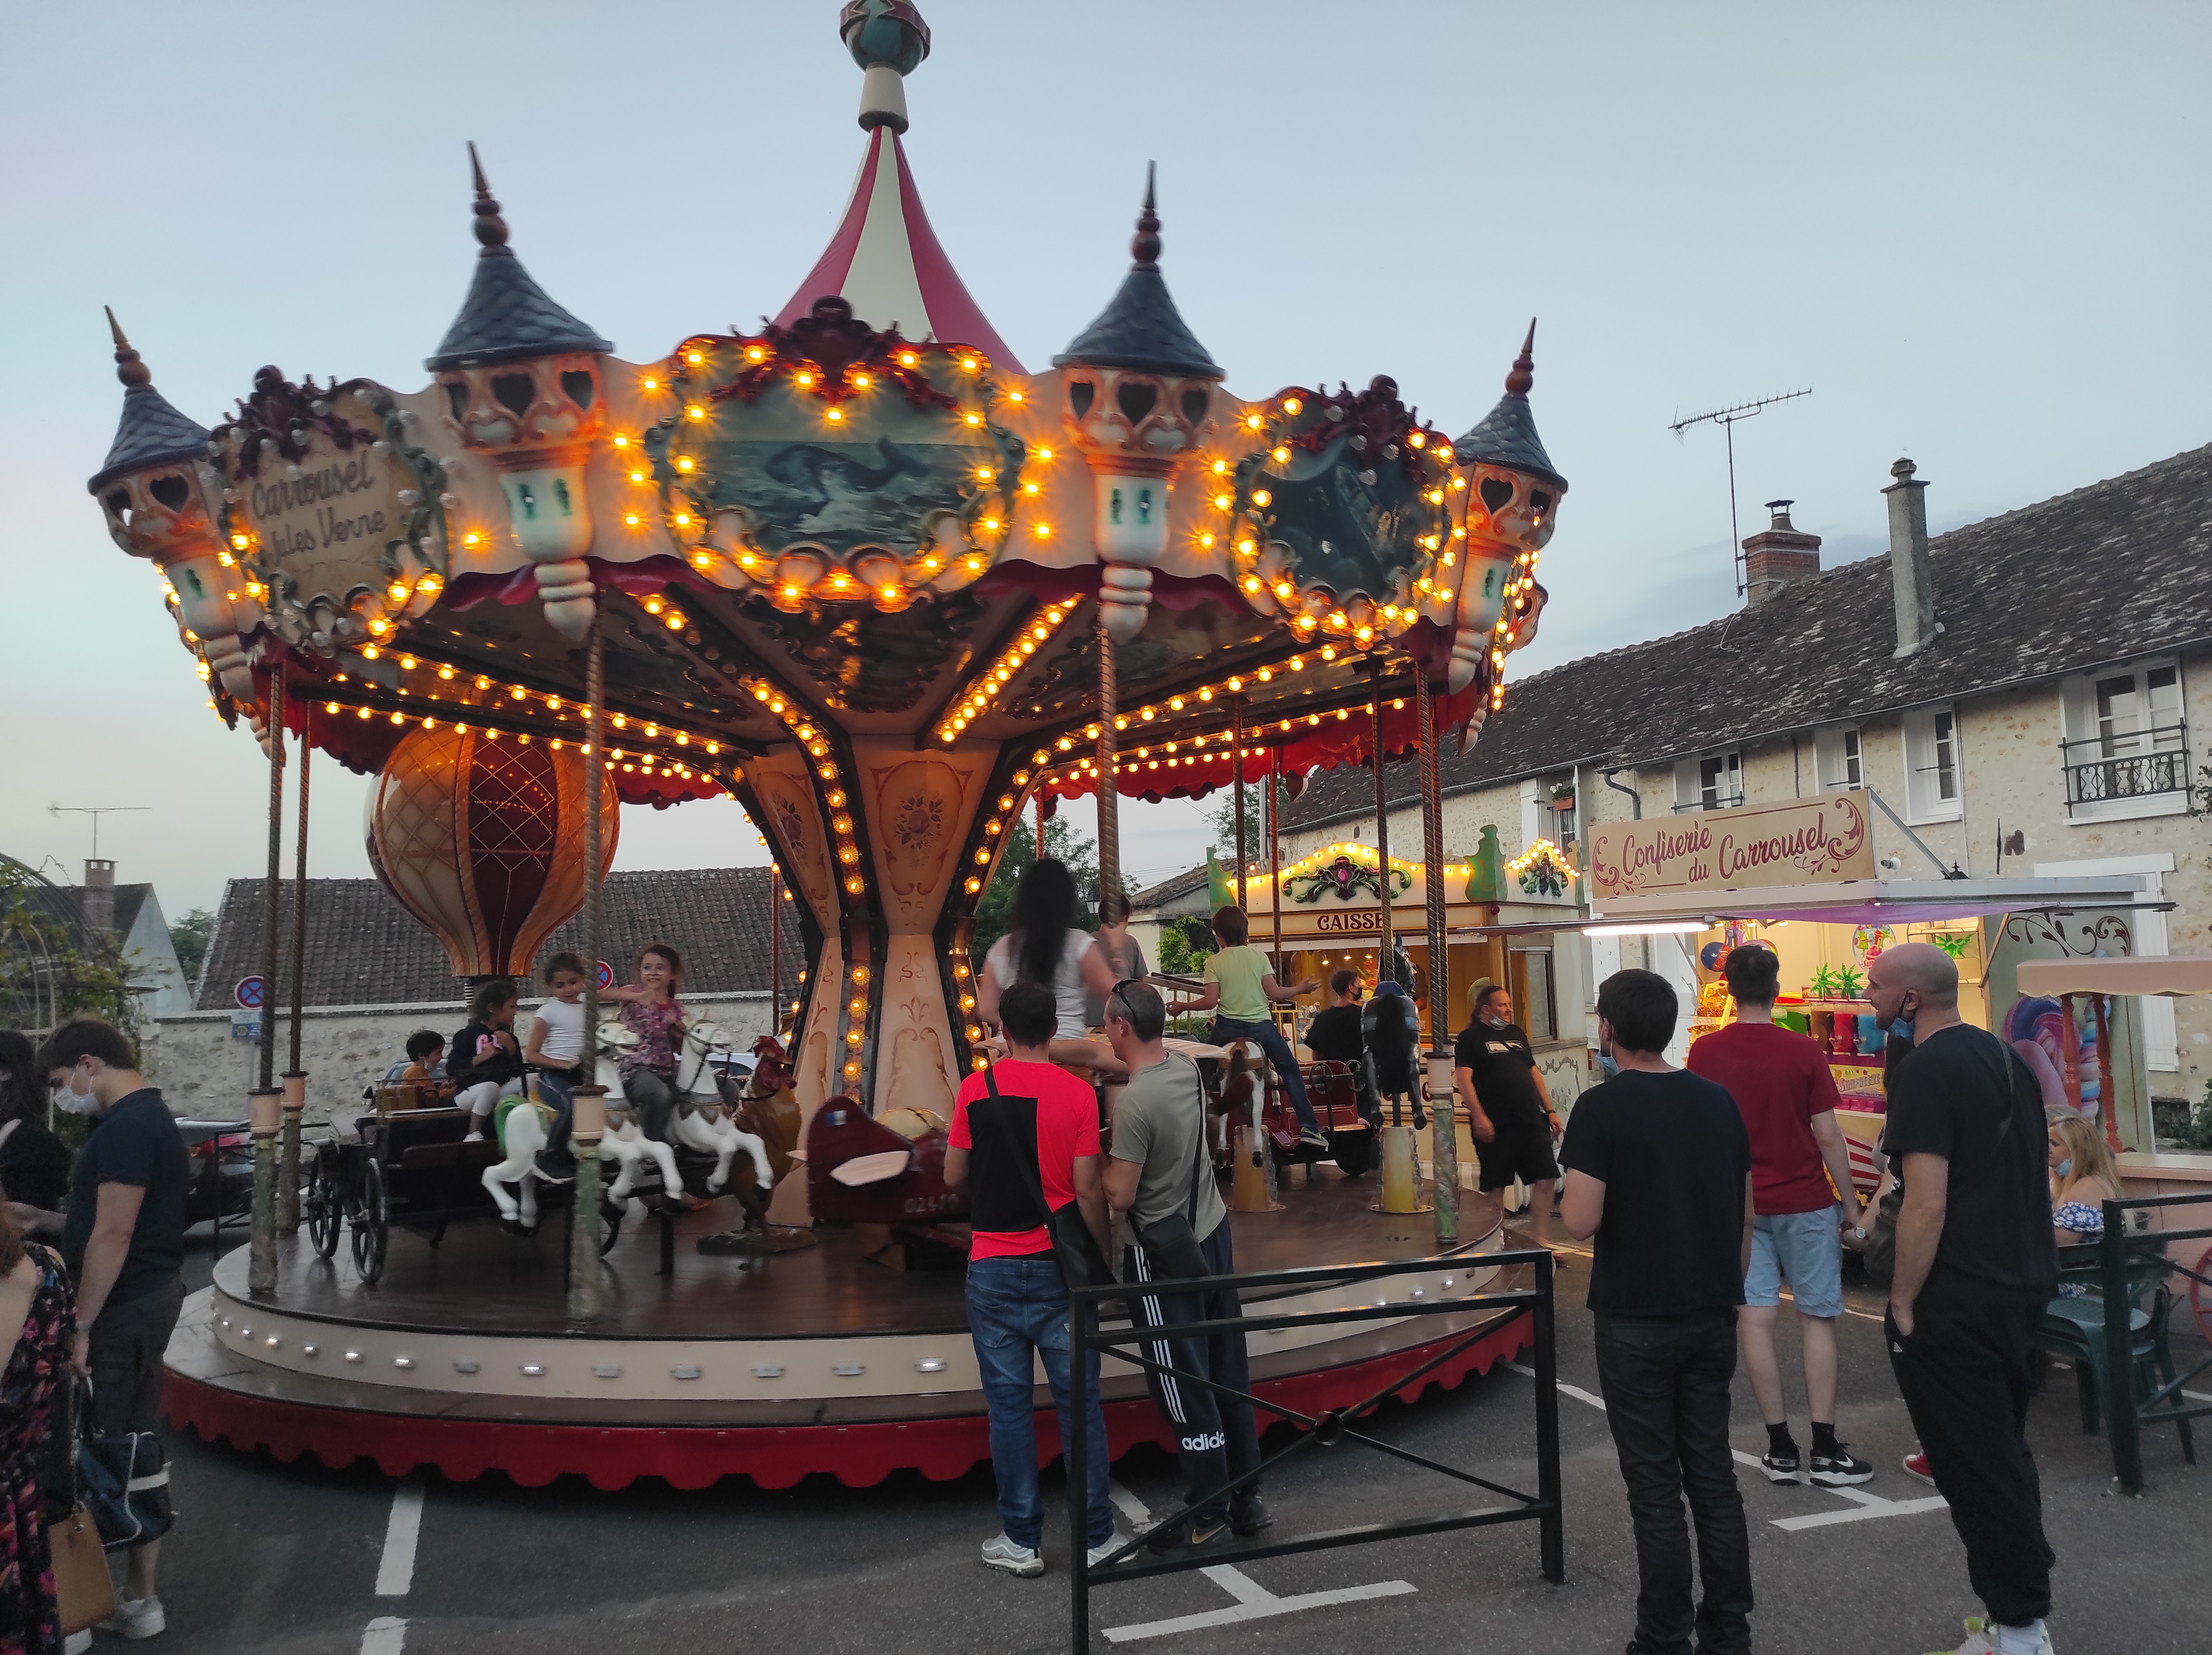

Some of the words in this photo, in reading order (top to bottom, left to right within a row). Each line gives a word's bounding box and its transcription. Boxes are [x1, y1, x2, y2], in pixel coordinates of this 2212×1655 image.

[317, 507, 387, 548] Verne
[1622, 820, 1712, 877] Confiserie
[1689, 858, 1710, 883] du
[1719, 812, 1828, 879] Carrousel
[1317, 912, 1383, 930] CAISSE
[1182, 1431, 1225, 1451] adida
